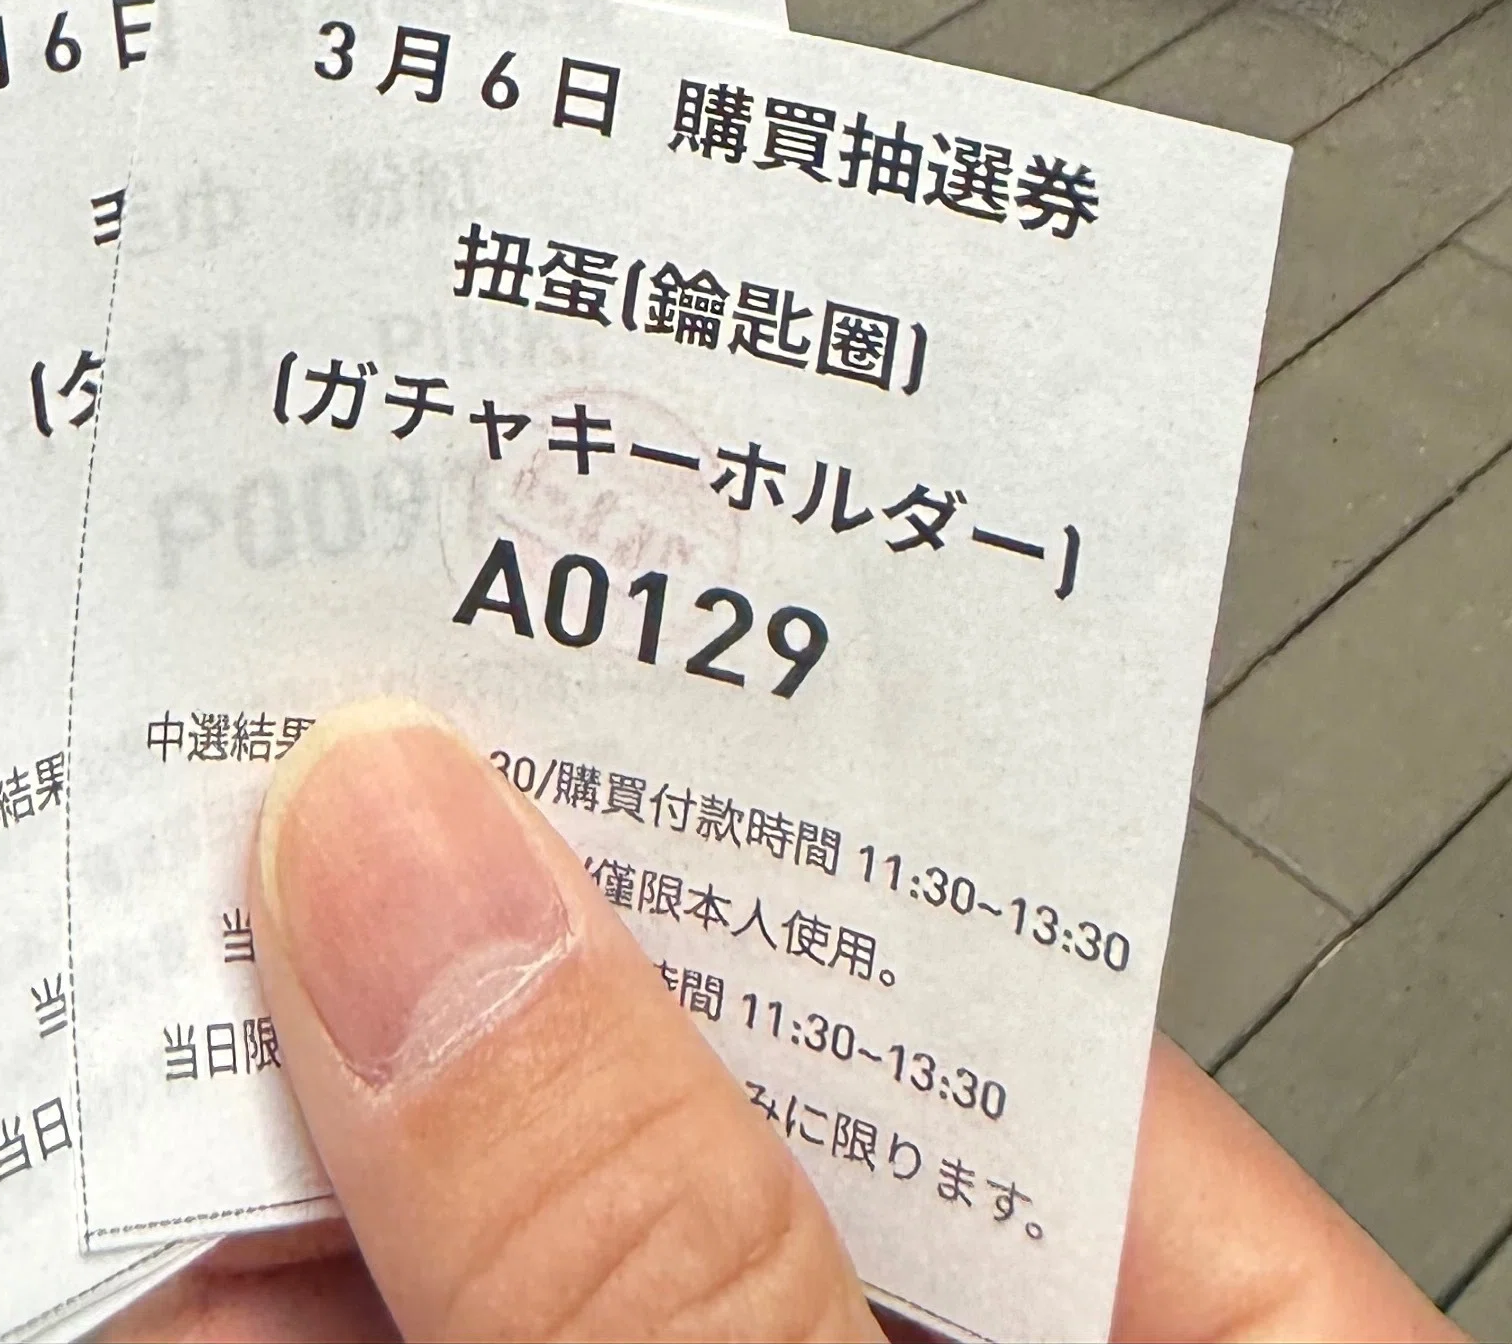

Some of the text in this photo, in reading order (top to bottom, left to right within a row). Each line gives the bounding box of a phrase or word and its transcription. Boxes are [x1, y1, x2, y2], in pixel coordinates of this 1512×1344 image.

[668, 78, 1101, 241] 購買抽選券
[453, 221, 928, 396] 扭蛋(鑰匙圈)
[273, 351, 1081, 601] (ガチャキーホルダー)
[452, 536, 830, 700] A0129
[584, 856, 897, 988] 僅限本人使用。
[859, 844, 1131, 974] 11:30~13:30
[163, 1015, 282, 1081] 当日限
[741, 993, 1008, 1121] 11:30~13:30
